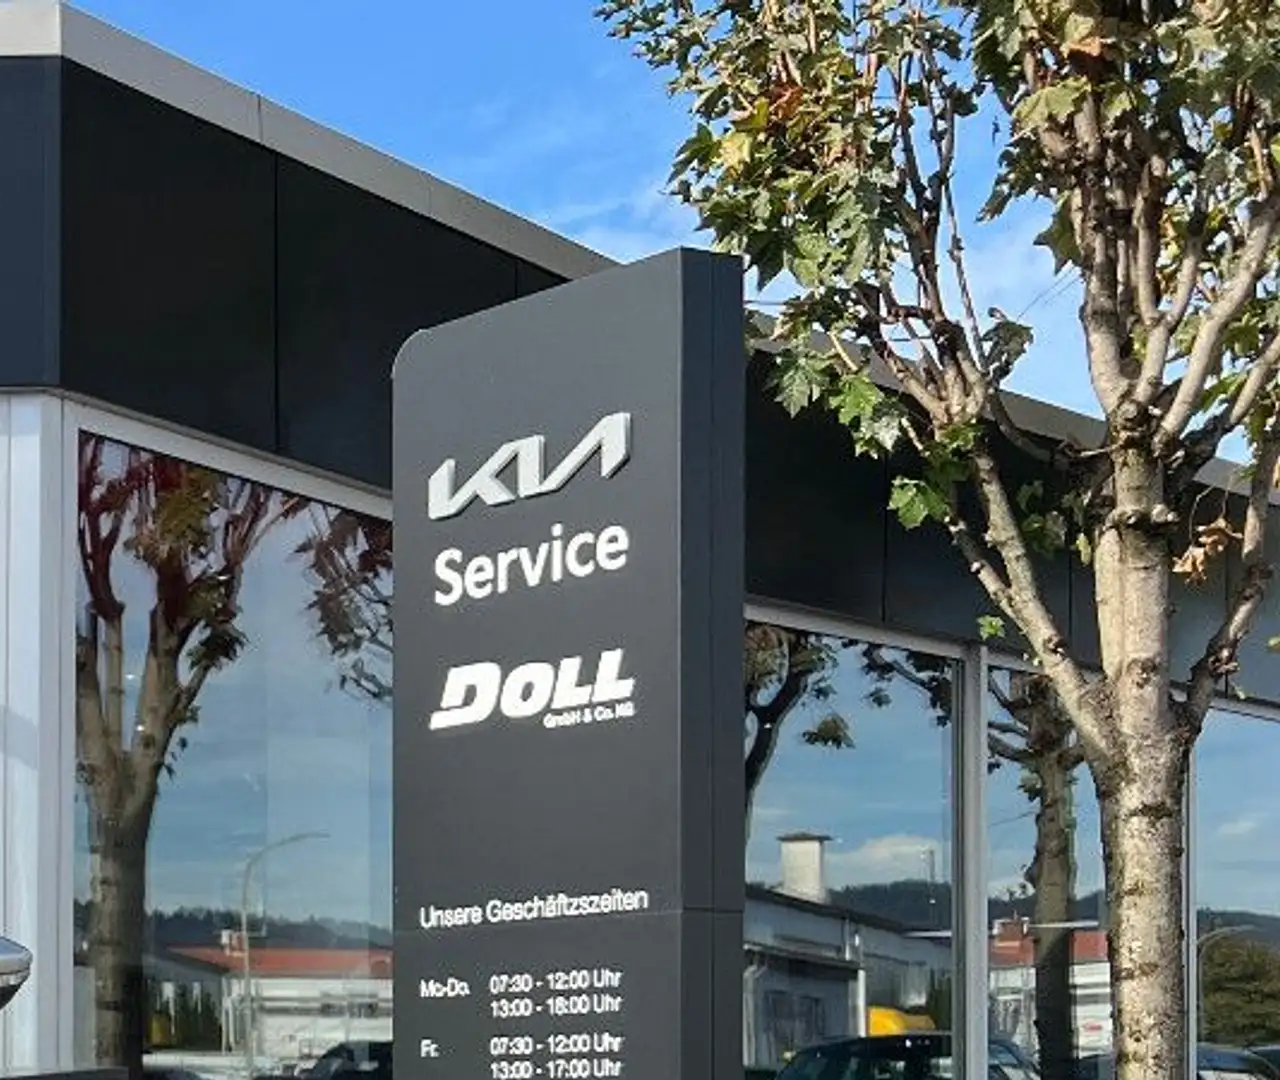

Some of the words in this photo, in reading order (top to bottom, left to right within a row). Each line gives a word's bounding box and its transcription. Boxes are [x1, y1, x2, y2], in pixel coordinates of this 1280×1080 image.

[434, 523, 629, 606] Service
[429, 648, 635, 730] DOLL
[420, 905, 482, 928] Unsere
[490, 974, 533, 994] 07:30
[546, 970, 590, 990] 12:00
[593, 968, 622, 988] Uhr
[490, 998, 533, 1018] 13:00
[593, 993, 622, 1014] Uhr
[490, 1037, 533, 1056] 07:30
[547, 1034, 591, 1053] 12:00
[593, 1032, 622, 1052] Uhr
[490, 1061, 533, 1080] 13:00
[546, 1059, 591, 1079] 17:00
[593, 1058, 622, 1078] Uhr
